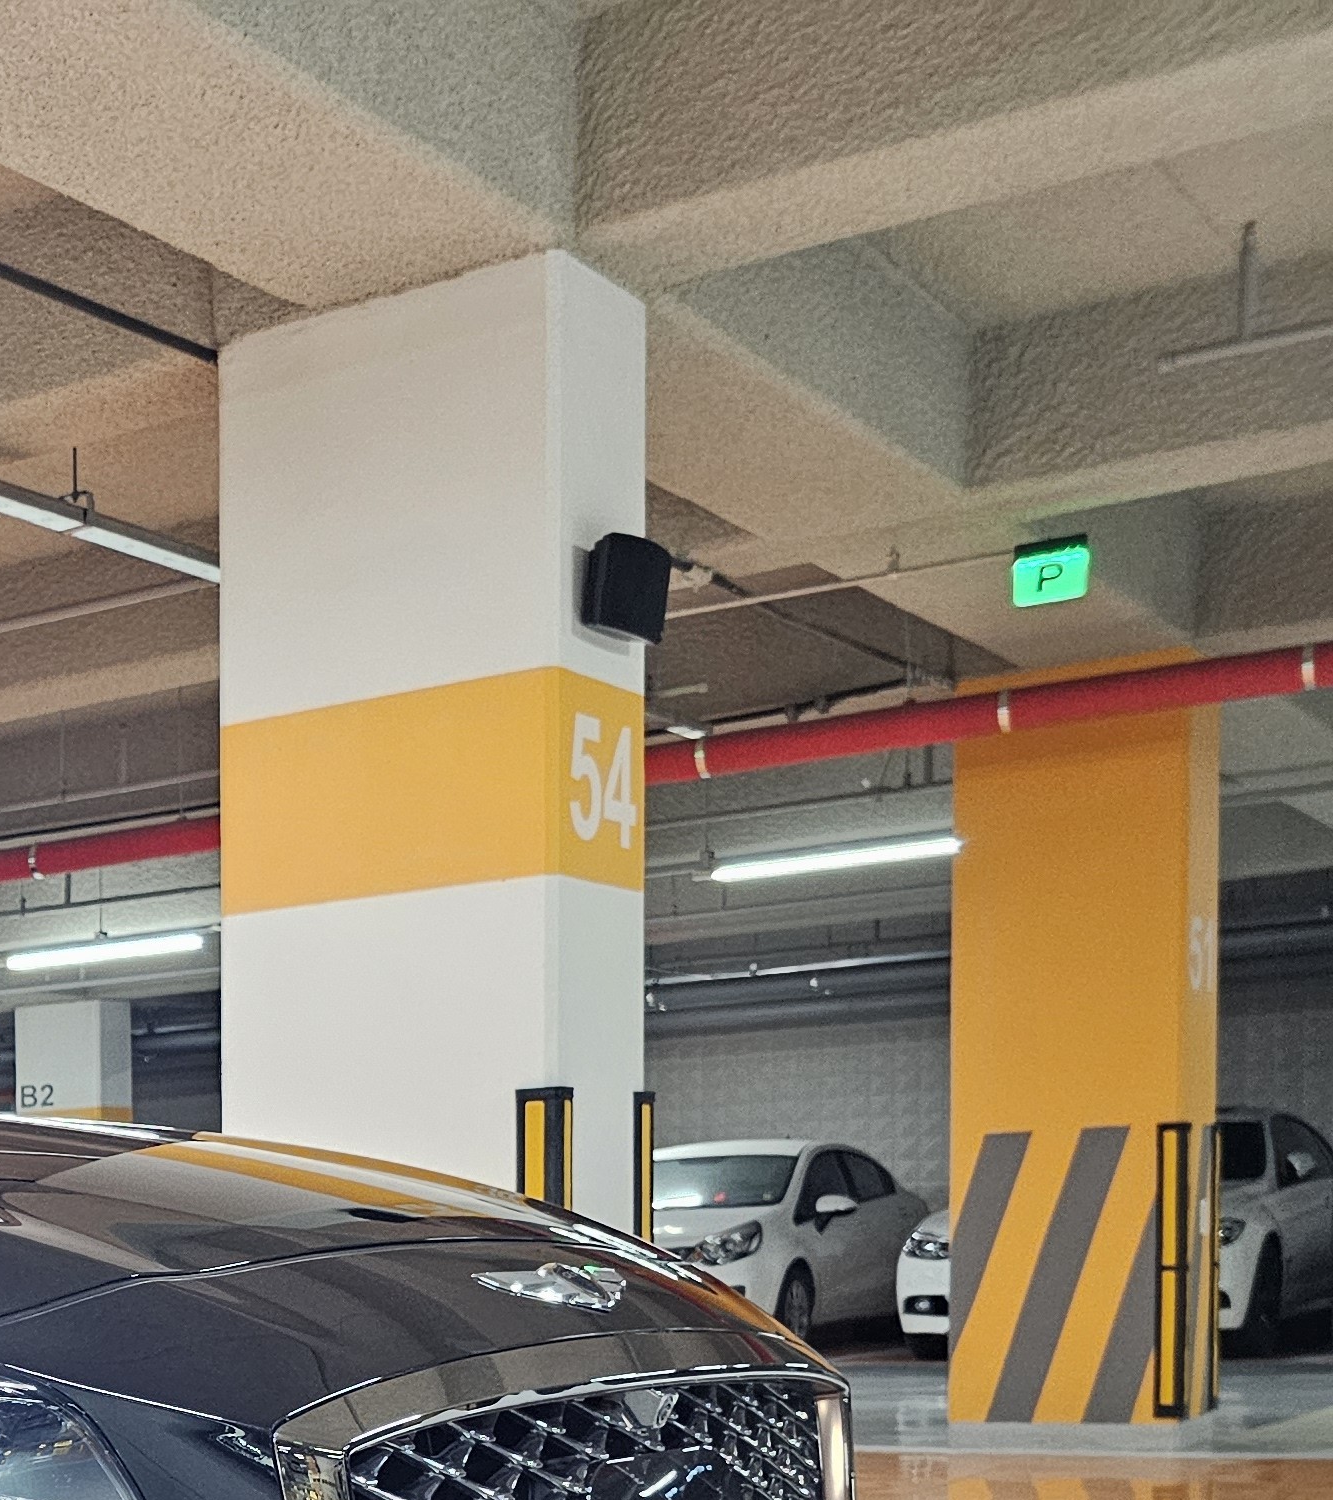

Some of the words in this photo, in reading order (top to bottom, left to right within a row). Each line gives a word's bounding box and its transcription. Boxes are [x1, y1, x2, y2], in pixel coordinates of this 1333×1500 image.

[1036, 563, 1064, 592] P
[569, 711, 638, 850] 54
[21, 1085, 54, 1108] B2
